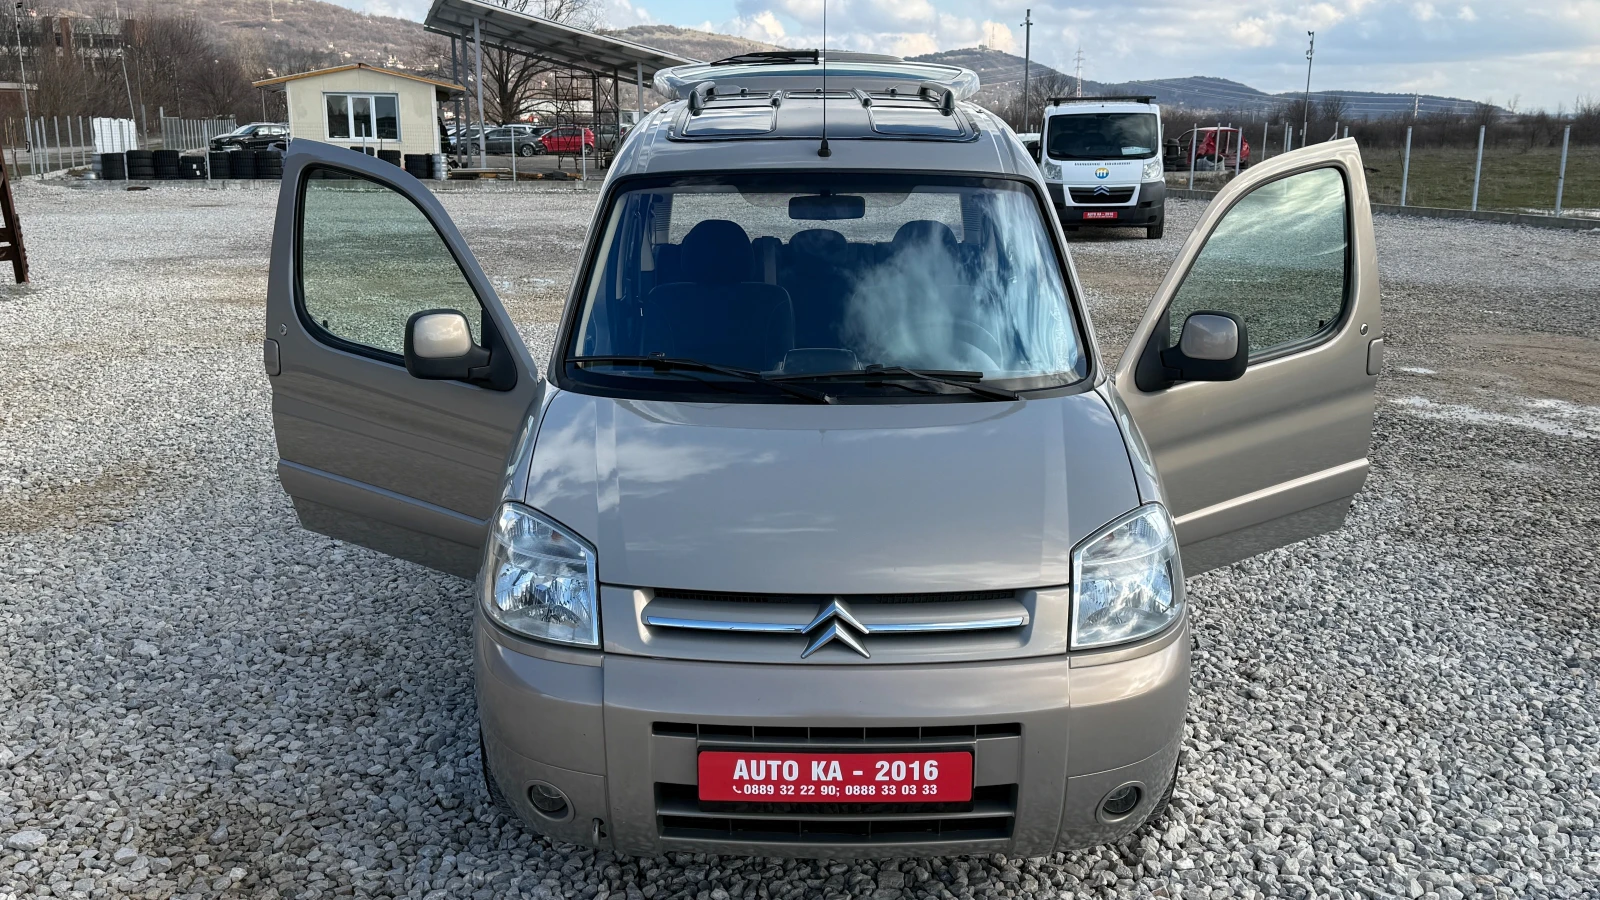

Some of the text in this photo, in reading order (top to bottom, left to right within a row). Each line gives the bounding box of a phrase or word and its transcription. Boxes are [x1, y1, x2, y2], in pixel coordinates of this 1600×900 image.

[733, 759, 799, 781] AUTO
[812, 760, 844, 781] KA
[875, 760, 939, 781] 2016
[743, 784, 775, 795] 0889
[780, 784, 795, 795] 32
[800, 784, 816, 795] 22
[845, 784, 876, 796] 0888
[881, 784, 897, 796] 33
[902, 784, 917, 795] 03
[923, 784, 938, 795] 33
